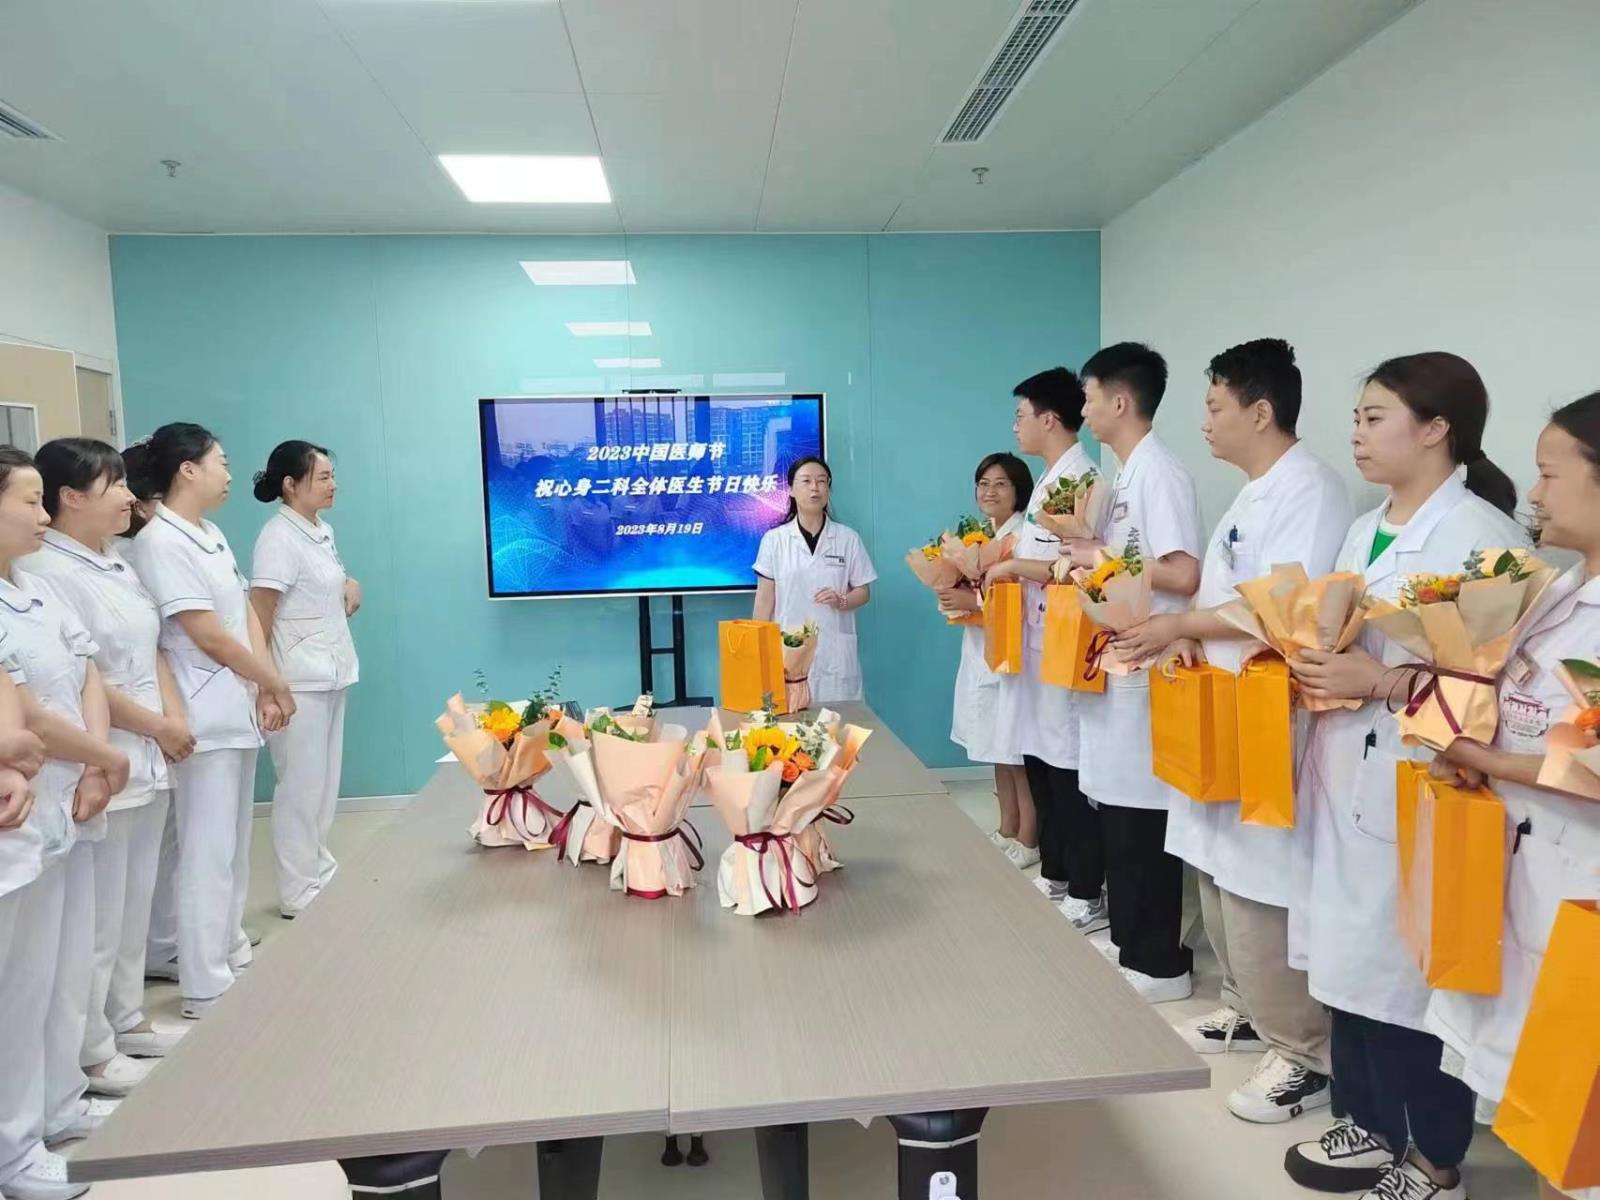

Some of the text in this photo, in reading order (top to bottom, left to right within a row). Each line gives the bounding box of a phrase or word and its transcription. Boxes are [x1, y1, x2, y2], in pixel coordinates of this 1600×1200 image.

[586, 441, 726, 462] 2023中国医师节
[535, 474, 778, 498] 祝心身二科全体医生节日快乐
[615, 522, 704, 536] 2023年8月19日
